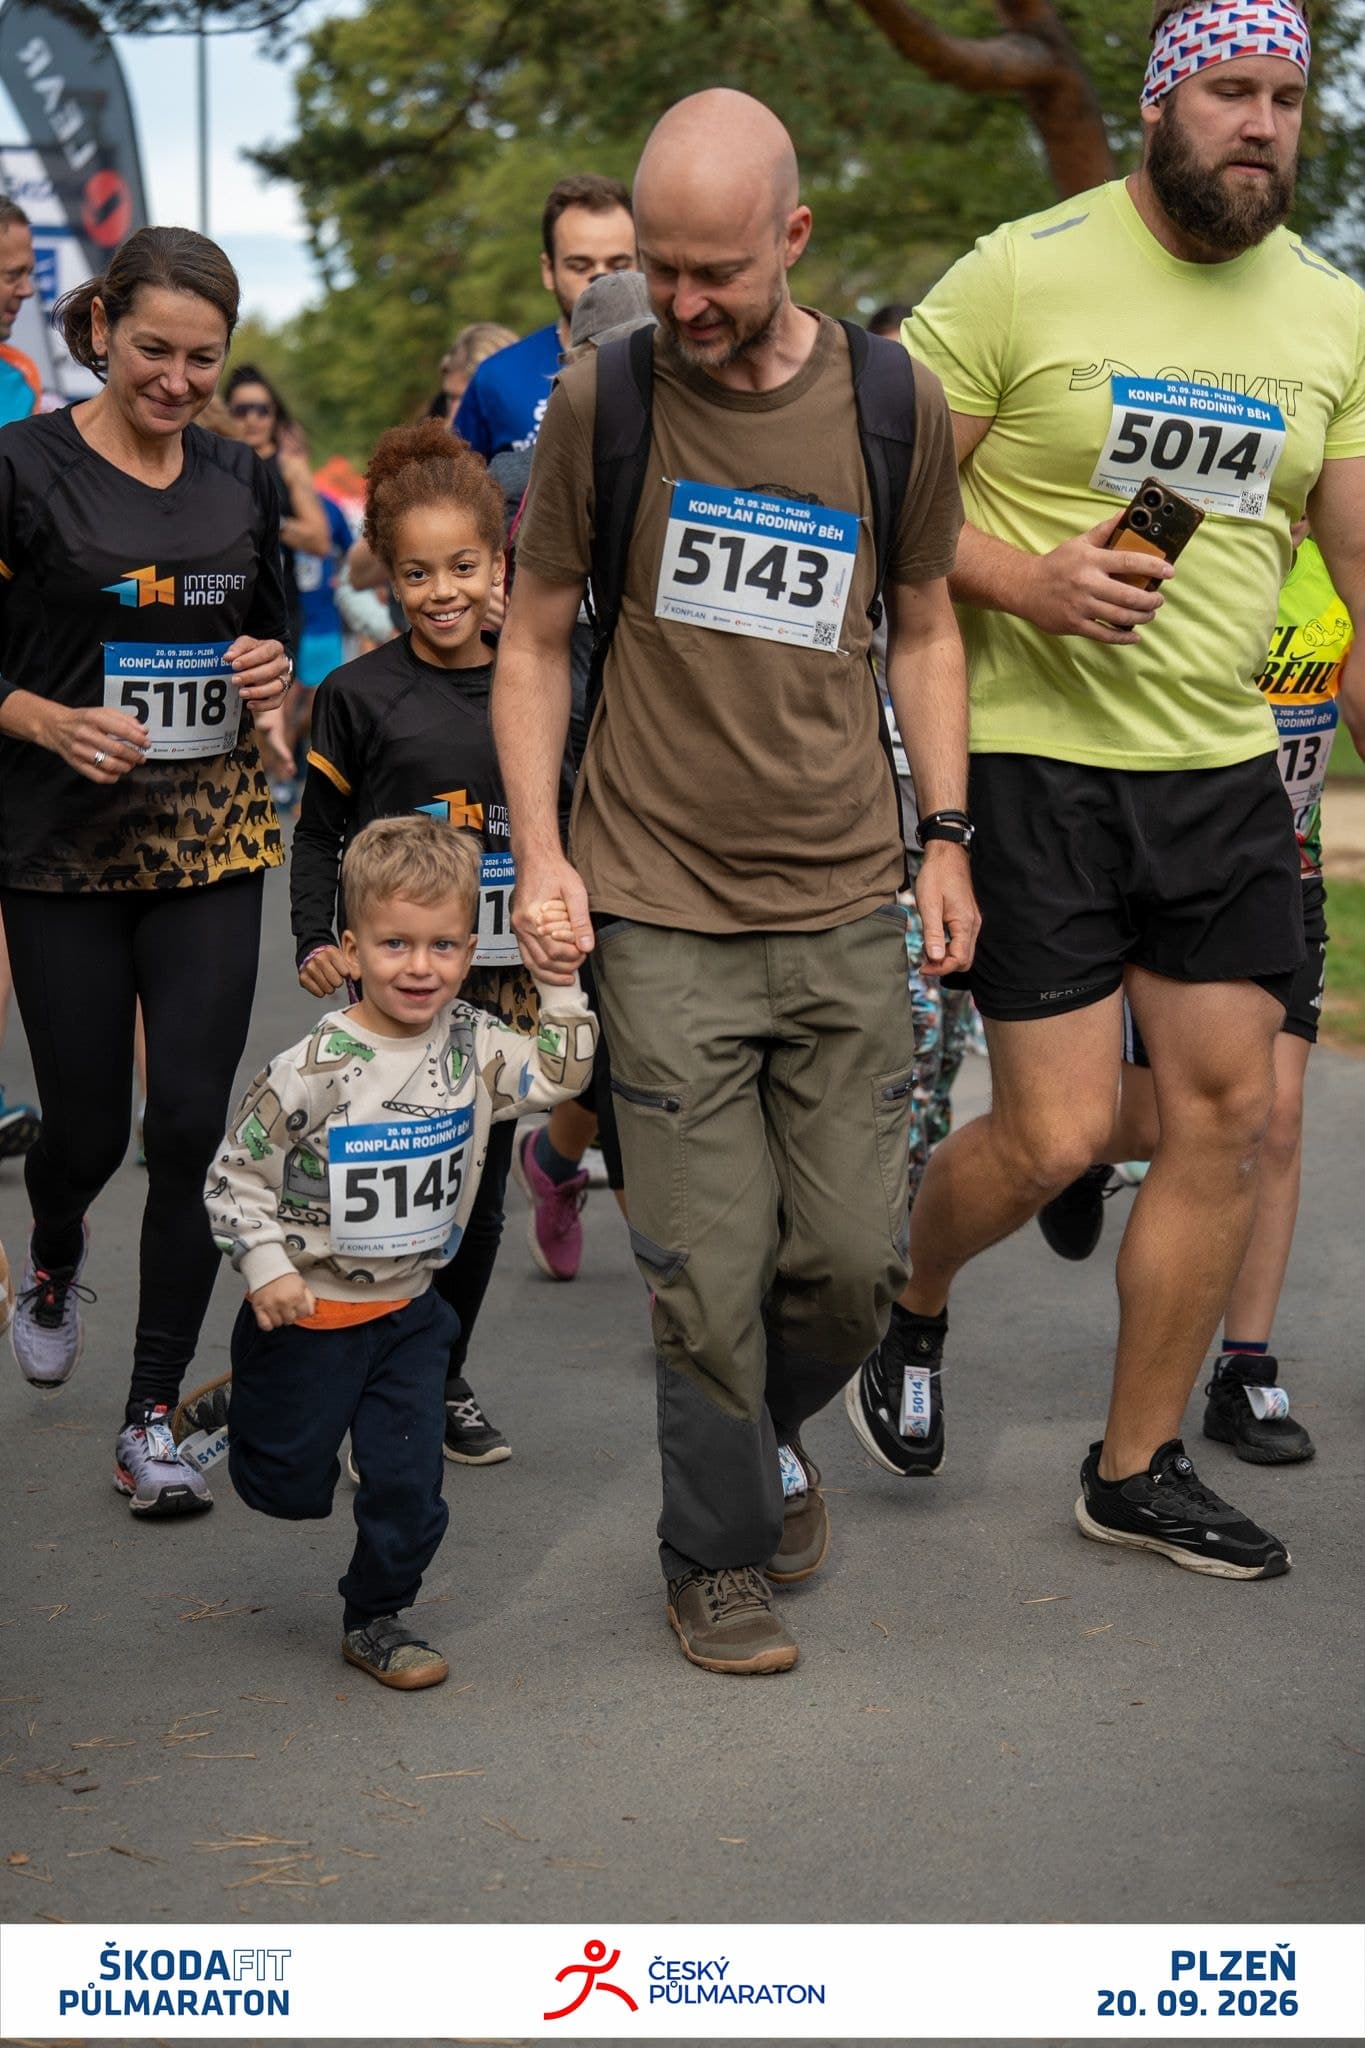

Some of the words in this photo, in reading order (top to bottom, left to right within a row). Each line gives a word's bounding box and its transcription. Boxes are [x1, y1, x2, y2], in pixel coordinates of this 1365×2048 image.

[1167, 384, 1179, 393] 20.
[1179, 386, 1191, 395] 09.
[1191, 388, 1209, 398] 2026
[1214, 391, 1236, 403] PLZEŇ
[1128, 388, 1188, 407] KONPLAN
[1189, 397, 1246, 417] RODINNÝ
[1247, 405, 1271, 422] BĚH
[1109, 412, 1262, 481] 5014
[733, 497, 746, 507] 20.
[747, 499, 760, 509] 09.
[761, 502, 780, 513] 2026
[785, 506, 811, 519] PLZEŇ
[688, 499, 755, 524] KONPLAN
[755, 513, 817, 535] RODINNÝ
[818, 524, 844, 541] BĚH
[672, 527, 829, 608] 5143
[184, 575, 246, 590] INTERNET
[184, 590, 225, 606] HNED
[119, 657, 173, 669] KONPLAN
[176, 656, 219, 669] RODINNÝ
[121, 679, 227, 728] 5118
[1277, 716, 1317, 728] RODINNÝ
[1317, 713, 1332, 725] BĚH
[1283, 736, 1321, 782] 13
[489, 804, 508, 821] INTE
[489, 820, 511, 837] HNE
[483, 866, 515, 878] RODINN
[345, 1140, 409, 1153] KONPLAN
[413, 1125, 457, 1149] RODINNÝ
[387, 1127, 399, 1136] 20.
[401, 1127, 413, 1136] 09.
[415, 1125, 432, 1134] 2026
[344, 1147, 464, 1223] 5145
[913, 1381, 924, 1413] 5014
